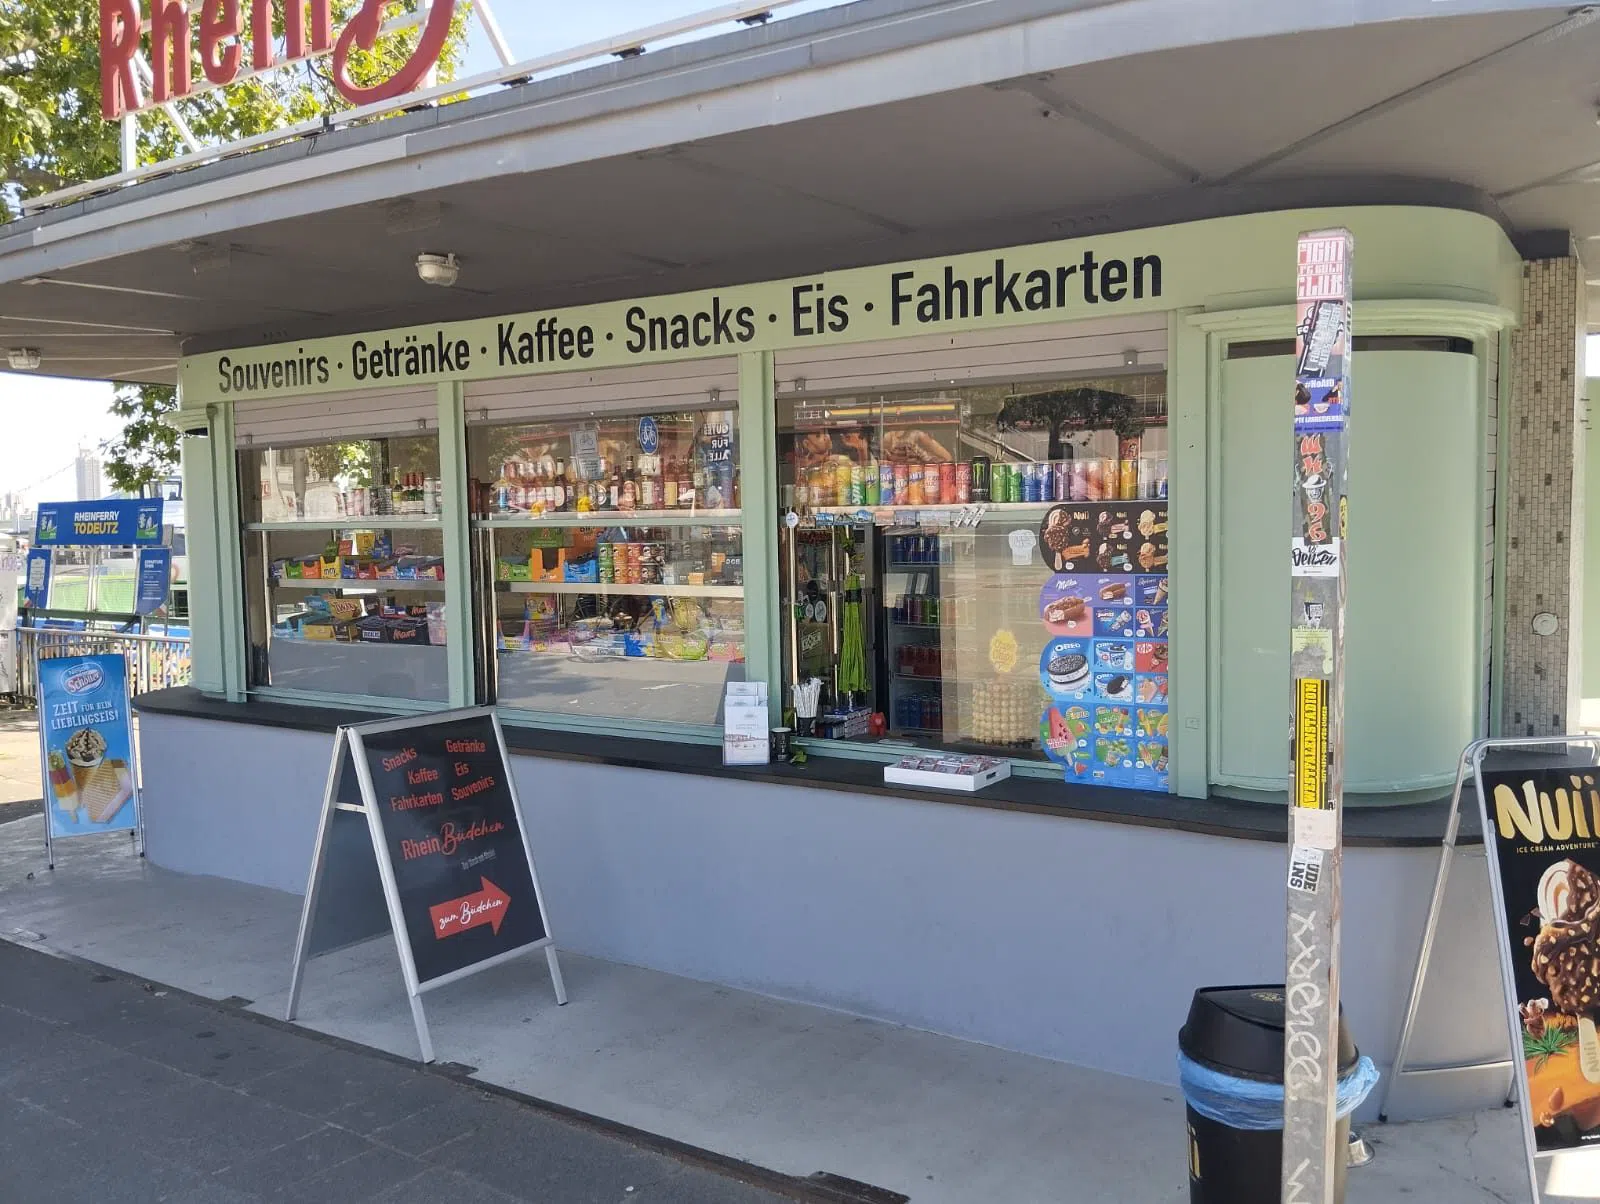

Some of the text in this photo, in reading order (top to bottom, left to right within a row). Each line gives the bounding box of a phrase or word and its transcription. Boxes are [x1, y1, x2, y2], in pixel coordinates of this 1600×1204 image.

[218, 250, 1163, 394] Souvenirs Getränke Kaffee Snacks Eis Fahrkarten
[74, 510, 120, 521] RHEINFERRY
[1055, 642, 1081, 652] OREO
[52, 700, 79, 717] ZEIT
[51, 709, 119, 730] LIEBLINGSEIS!
[445, 739, 486, 753] Getränke
[1303, 682, 1318, 803] WESTFALENSTADION
[382, 746, 418, 772] Snacks
[454, 762, 470, 777] Eis
[407, 767, 440, 785] Kaffee
[451, 775, 495, 800] Souvenirs
[391, 791, 443, 812] Fahrkarten
[402, 835, 441, 861] Rhein
[439, 819, 505, 856] Büdchen
[1530, 844, 1554, 853] CREAM
[439, 899, 504, 929] zum Büdchen
